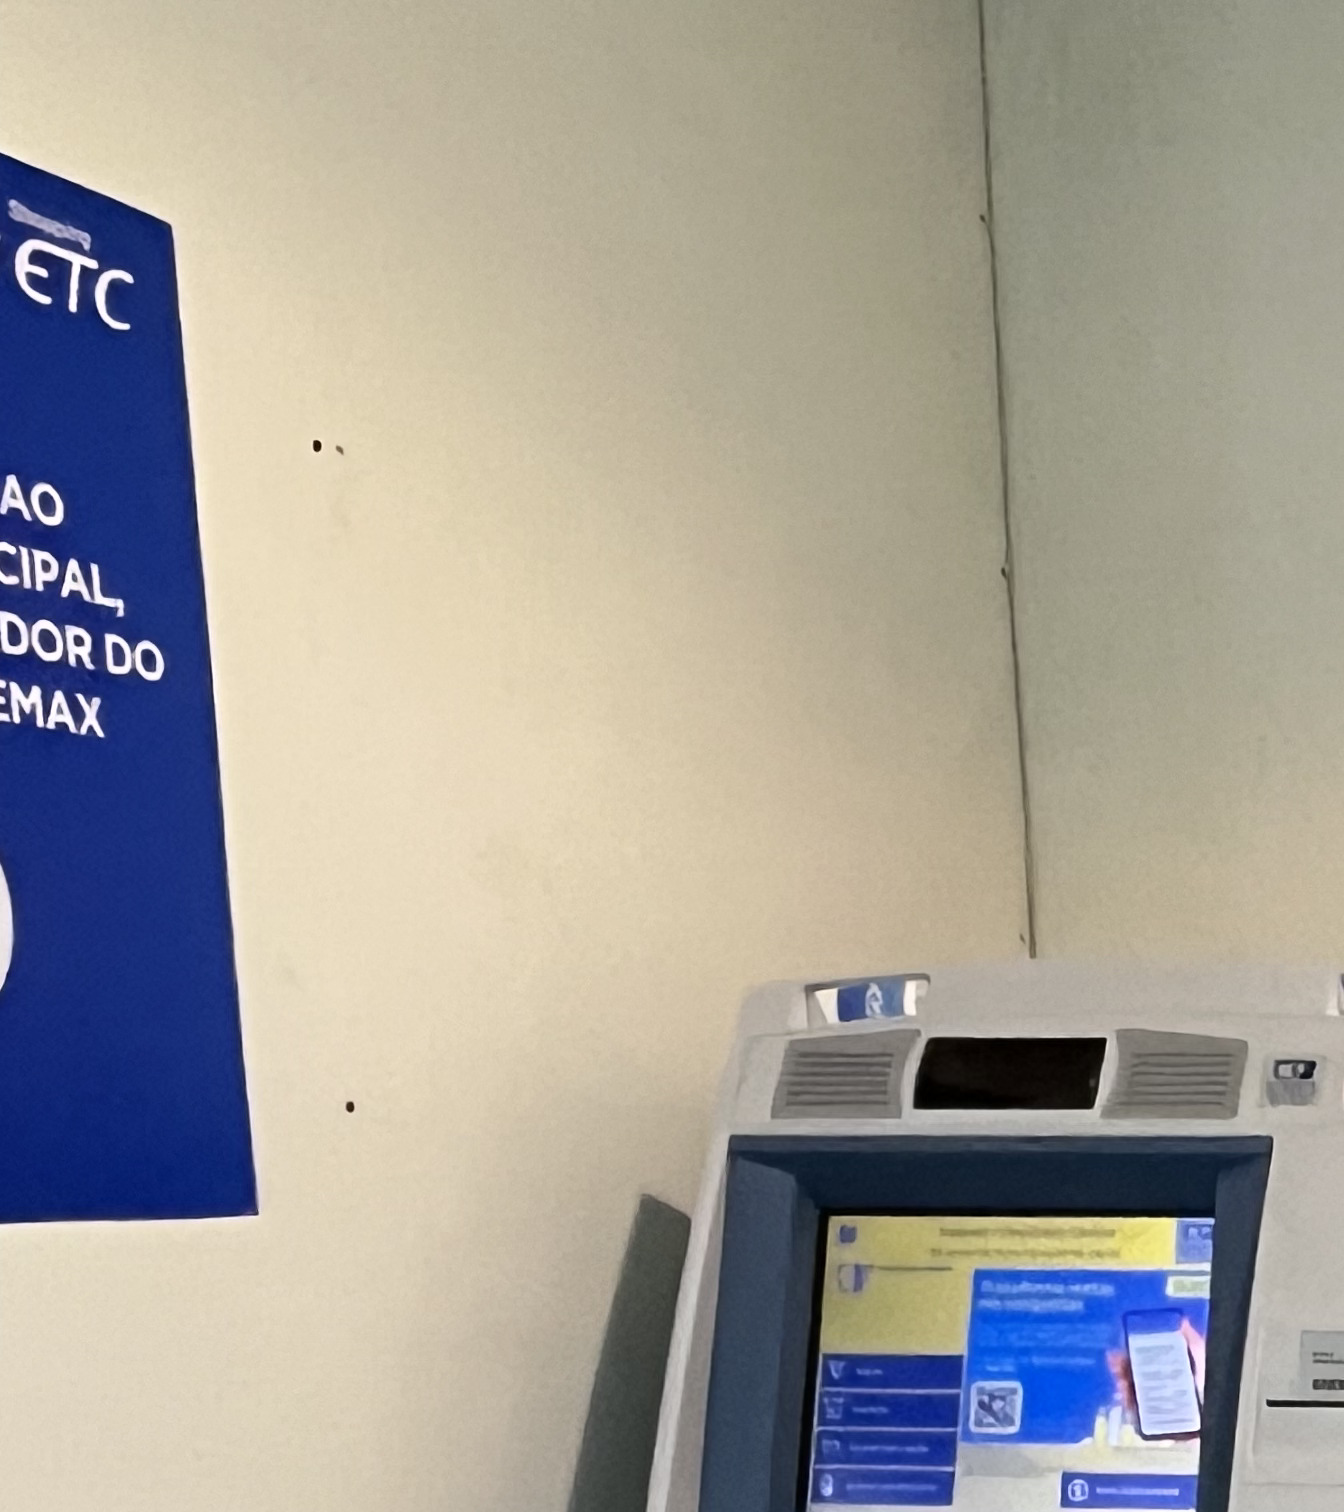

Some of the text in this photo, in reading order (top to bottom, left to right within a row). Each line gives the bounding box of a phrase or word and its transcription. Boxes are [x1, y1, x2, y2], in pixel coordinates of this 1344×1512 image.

[14, 238, 135, 331] ETC
[0, 474, 64, 527] AO
[0, 541, 125, 618] CIPAL,
[0, 611, 165, 682] DOR DO
